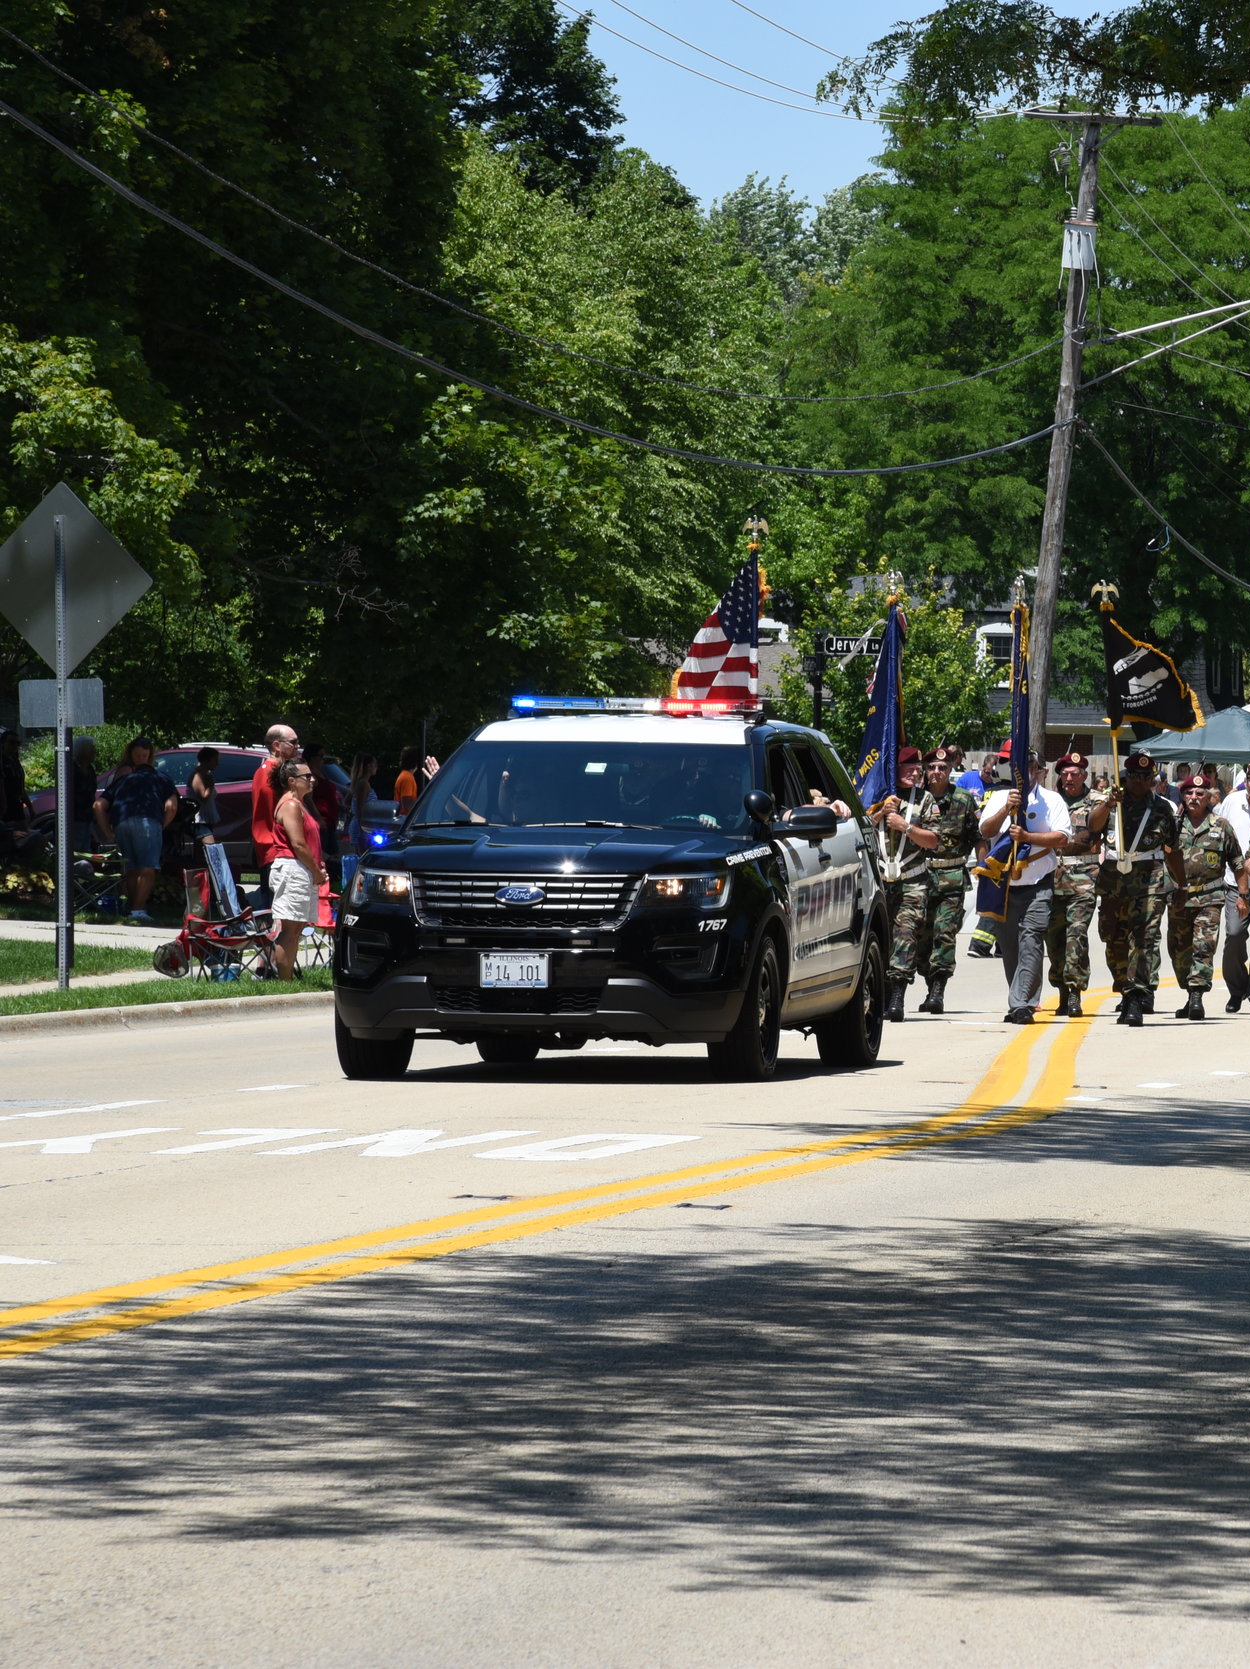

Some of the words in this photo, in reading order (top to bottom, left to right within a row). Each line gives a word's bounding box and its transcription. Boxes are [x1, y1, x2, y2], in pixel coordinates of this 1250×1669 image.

[1126, 695, 1158, 708] FORGOTTEN
[858, 748, 880, 778] WARS
[698, 918, 727, 932] 1767
[496, 964, 510, 981] 14
[519, 964, 541, 981] 101
